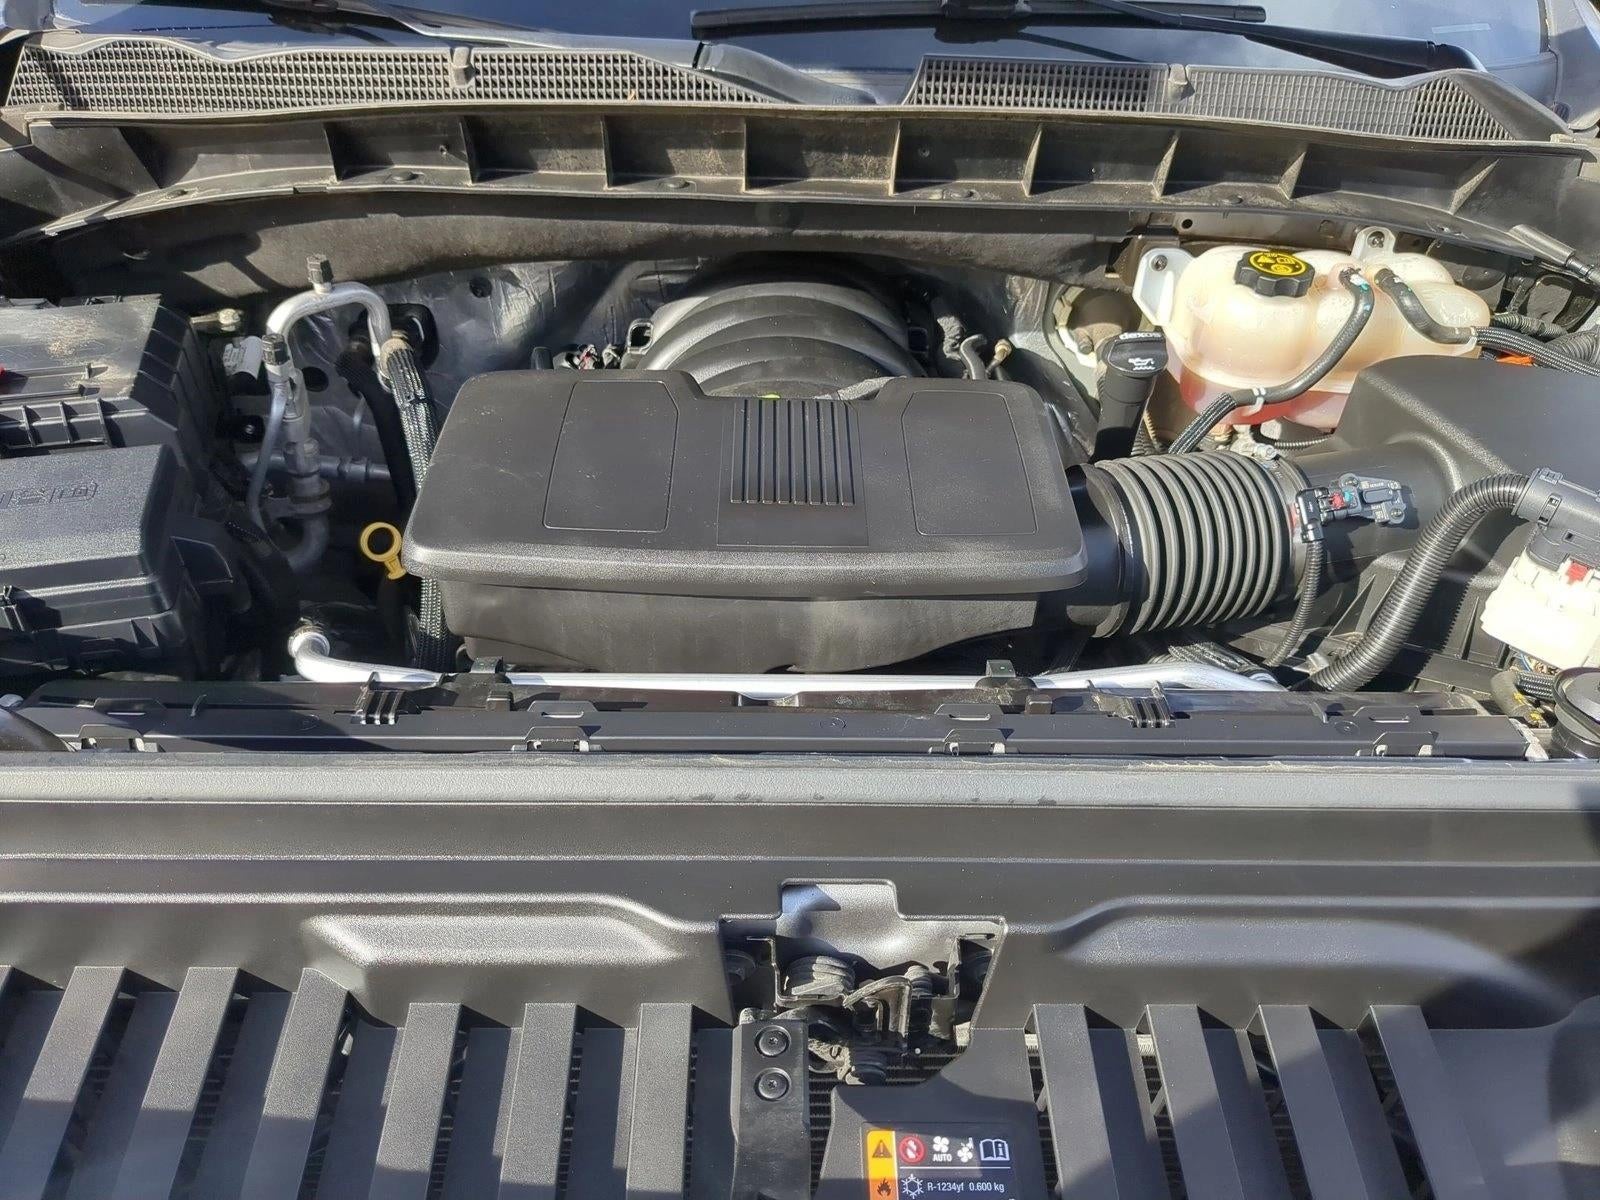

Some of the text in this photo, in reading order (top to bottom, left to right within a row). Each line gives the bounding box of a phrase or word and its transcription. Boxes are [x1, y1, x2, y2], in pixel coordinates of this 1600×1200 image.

[1119, 332, 1162, 340] dexos
[932, 1154, 952, 1162] AUTO
[927, 1182, 1005, 1193] R-1234yf 0.600 kg
